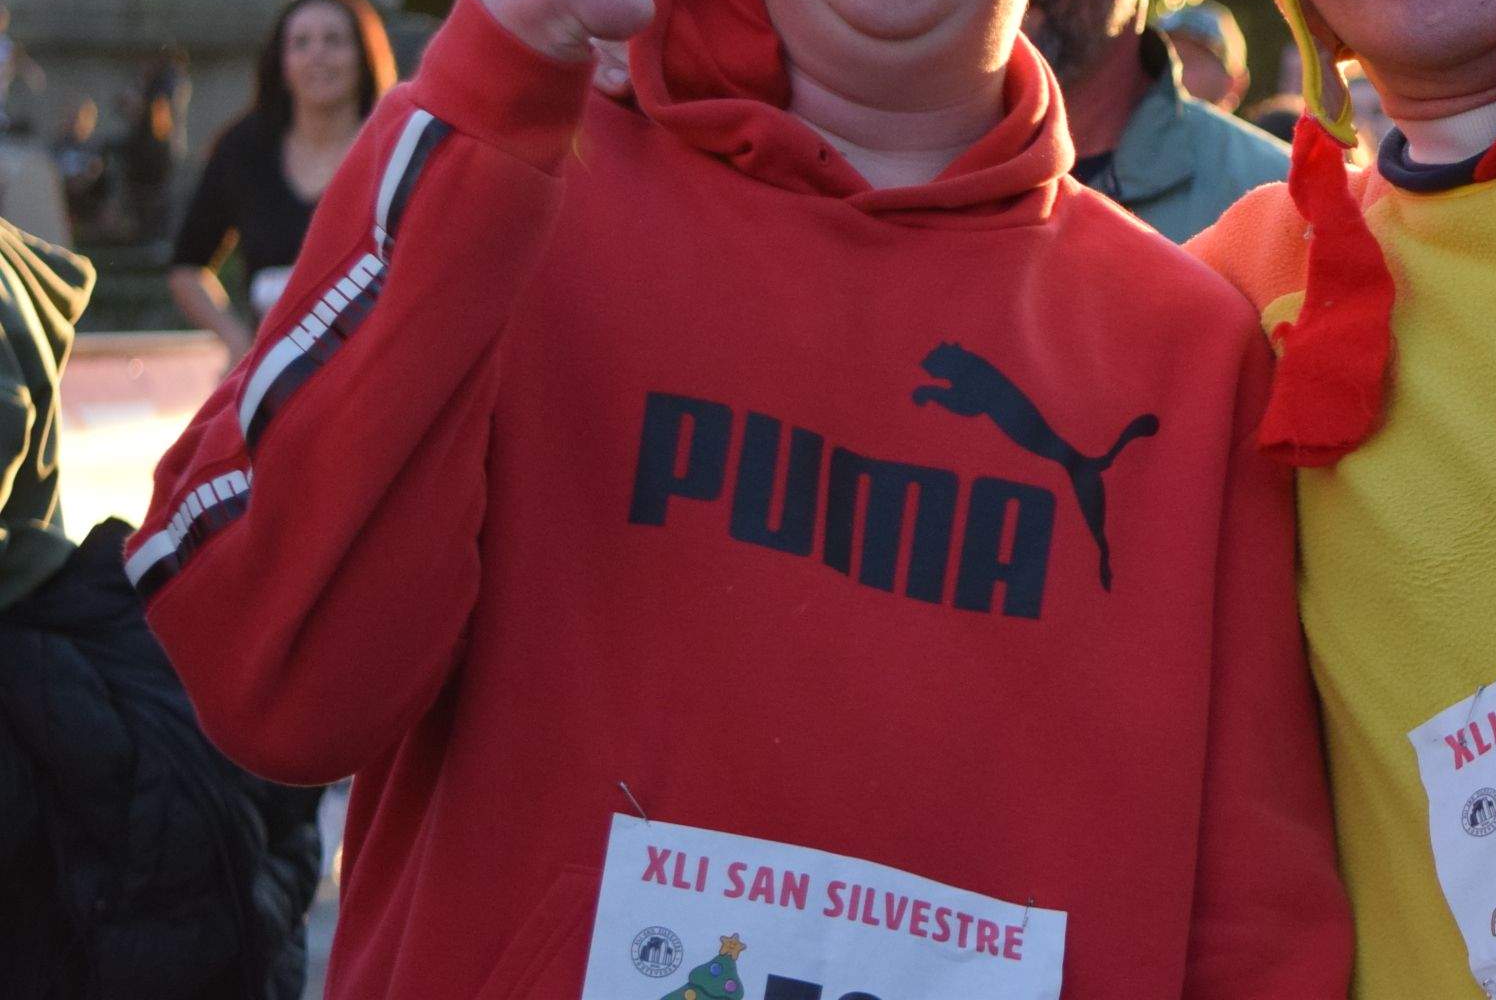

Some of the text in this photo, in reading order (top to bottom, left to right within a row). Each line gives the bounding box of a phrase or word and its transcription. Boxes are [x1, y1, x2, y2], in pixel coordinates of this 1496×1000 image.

[627, 390, 1056, 620] PUMA
[641, 845, 1024, 961] XLI SAN SILVESTRE
